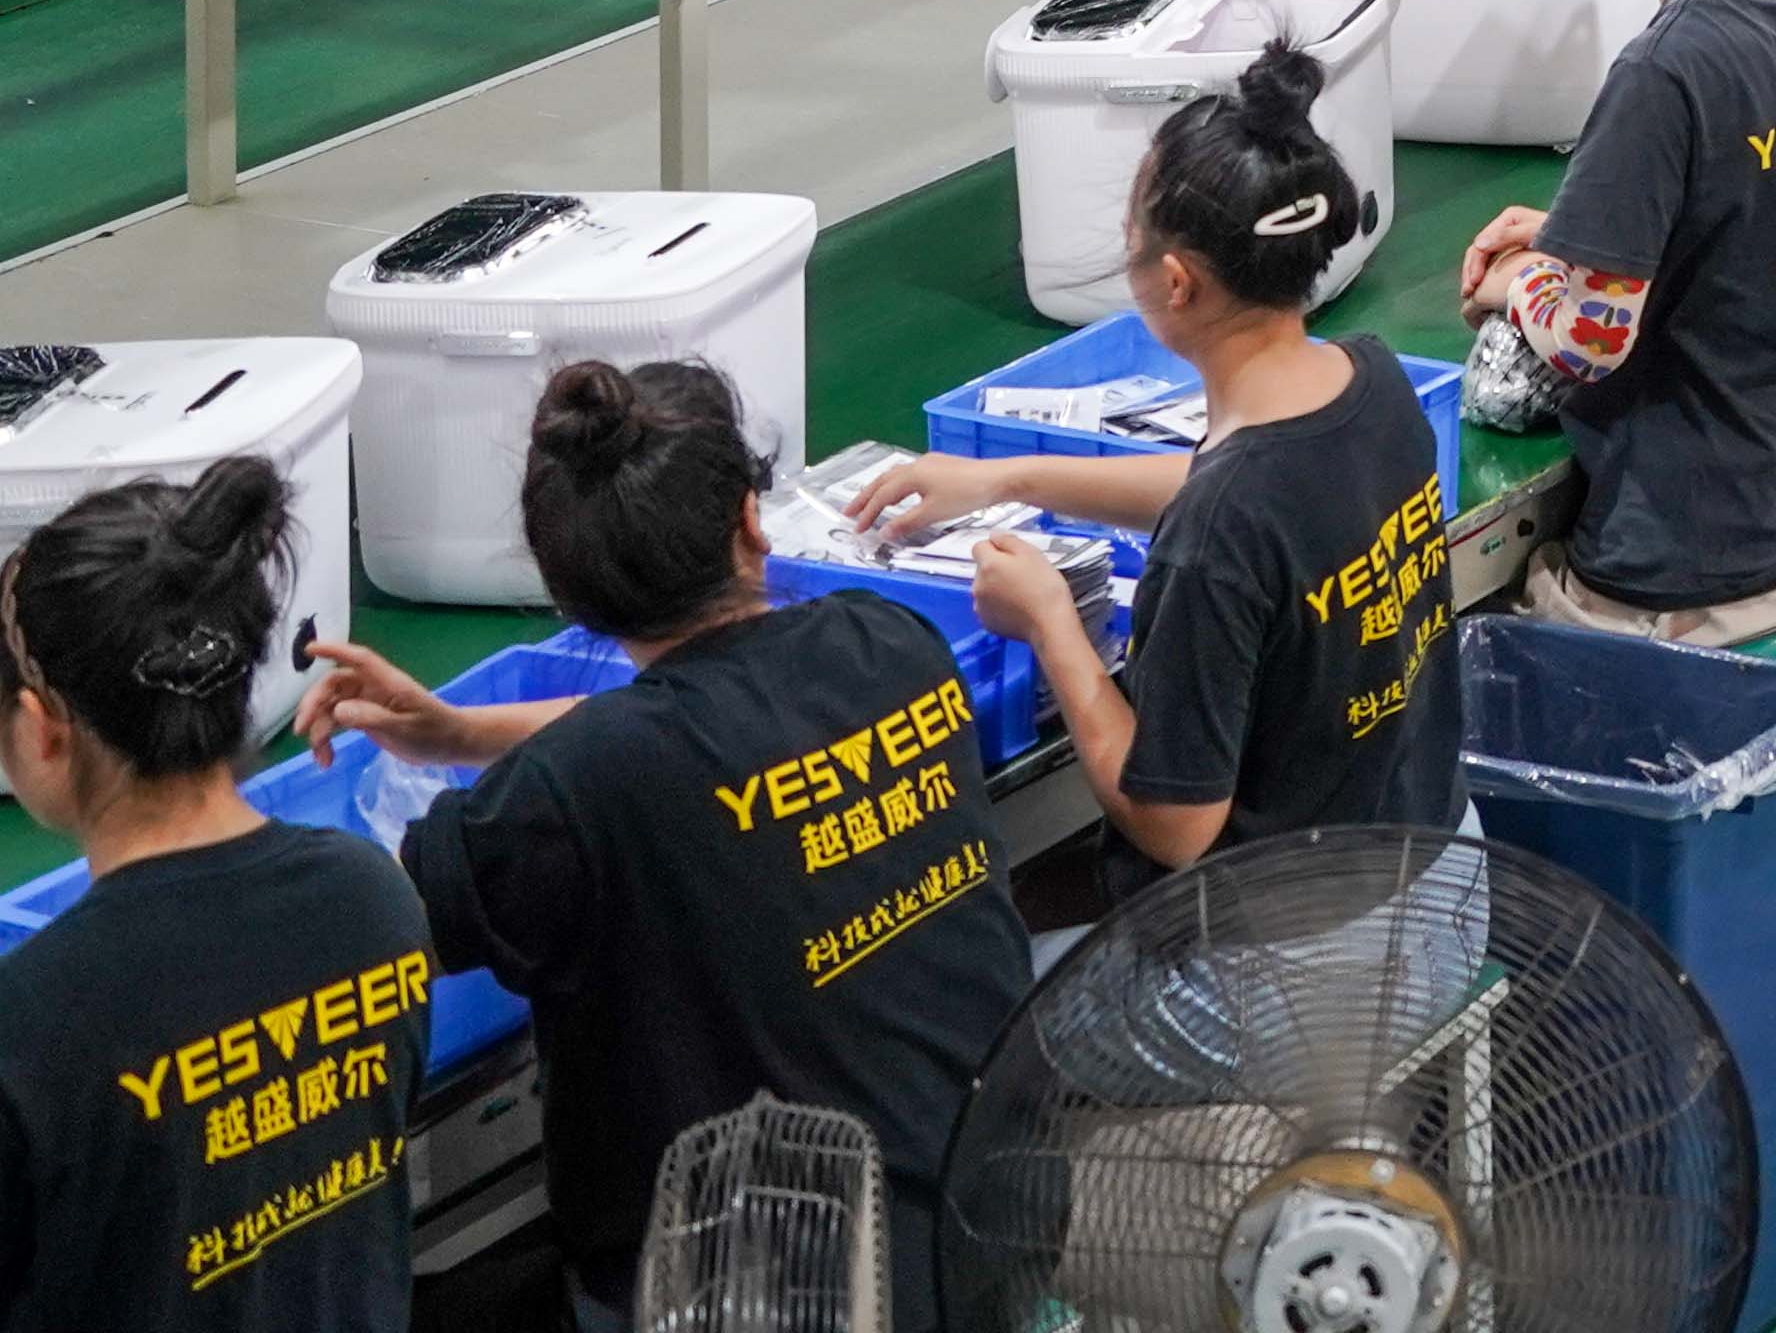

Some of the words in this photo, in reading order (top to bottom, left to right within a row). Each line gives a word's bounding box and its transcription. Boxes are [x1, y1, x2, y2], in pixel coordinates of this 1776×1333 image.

[799, 761, 956, 874] 越盛威尔
[204, 1042, 389, 1165] 越盛威尔
